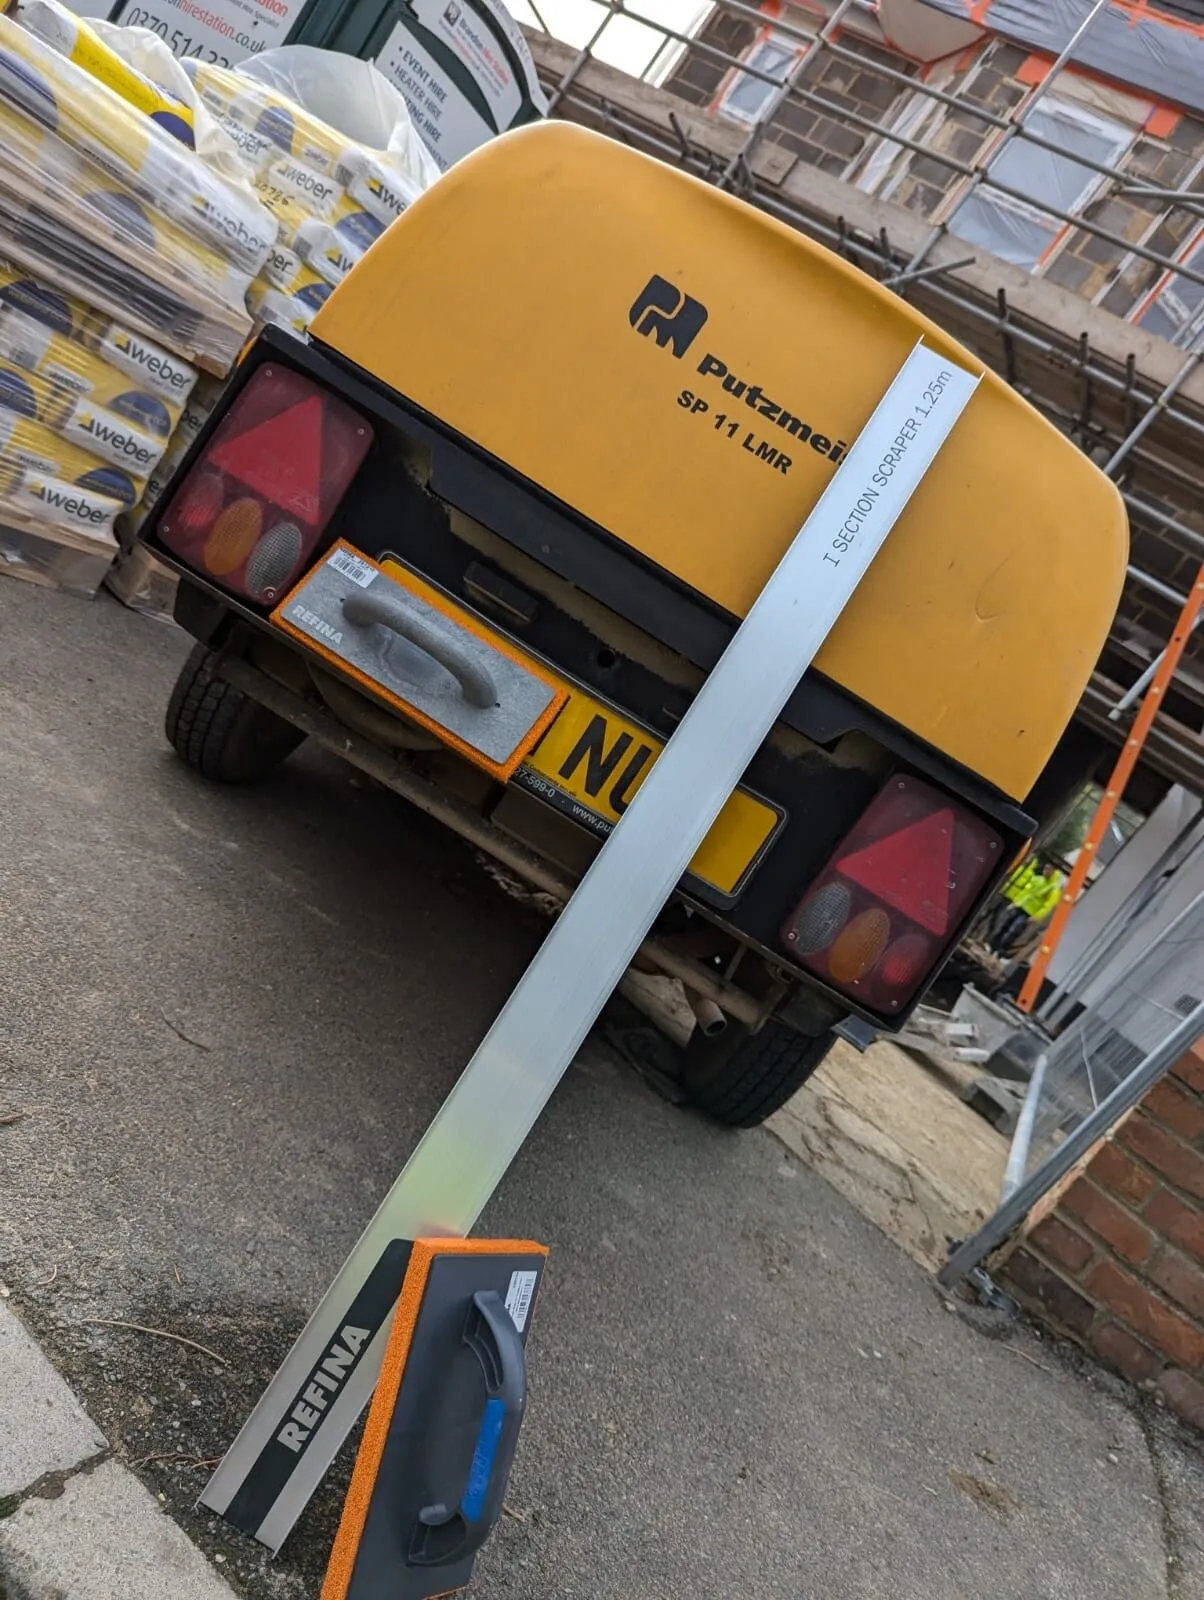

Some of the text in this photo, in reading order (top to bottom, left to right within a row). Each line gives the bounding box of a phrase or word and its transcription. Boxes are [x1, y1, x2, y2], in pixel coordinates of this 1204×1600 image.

[394, 64, 426, 102] HEATER
[423, 97, 443, 121] HIRE
[402, 50, 448, 105] EVENT HIRE
[422, 118, 442, 144] HIRE
[131, 342, 192, 389] weber
[677, 390, 793, 475] SP 11 LMR
[697, 353, 848, 466] Putzmei
[94, 421, 157, 464] weber
[832, 487, 880, 553] SECTION
[872, 417, 922, 487] SCRAPER
[914, 370, 953, 419] 1.25m
[46, 488, 112, 525] weber
[291, 604, 343, 645] REFINA
[571, 804, 612, 834] www.pu
[276, 1325, 373, 1453] REFINA
